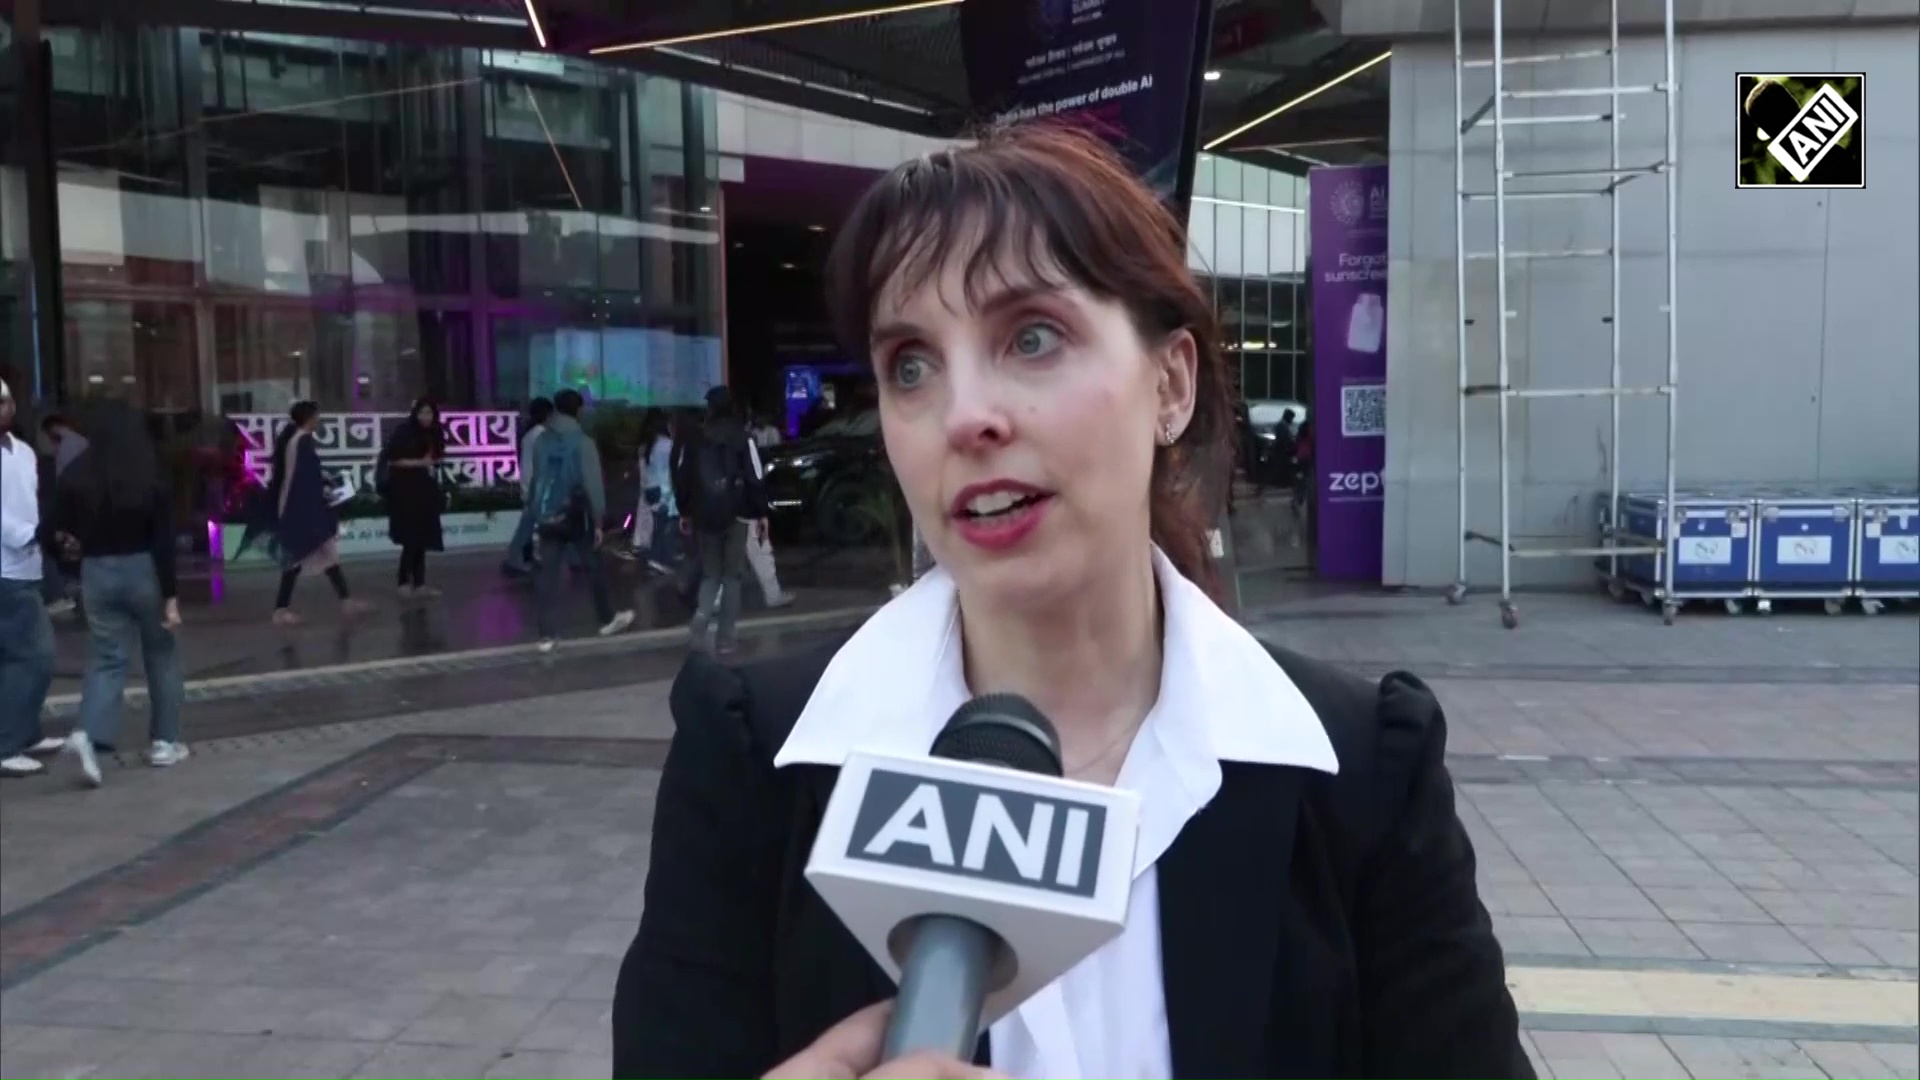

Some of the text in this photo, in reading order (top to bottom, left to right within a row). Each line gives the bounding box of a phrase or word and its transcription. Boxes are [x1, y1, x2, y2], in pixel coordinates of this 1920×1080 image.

[1038, 101, 1055, 116] the
[1056, 94, 1087, 113] power
[1088, 88, 1100, 103] of
[1101, 80, 1139, 100] double
[1140, 74, 1153, 90] AI
[863, 783, 1089, 888] ANI
